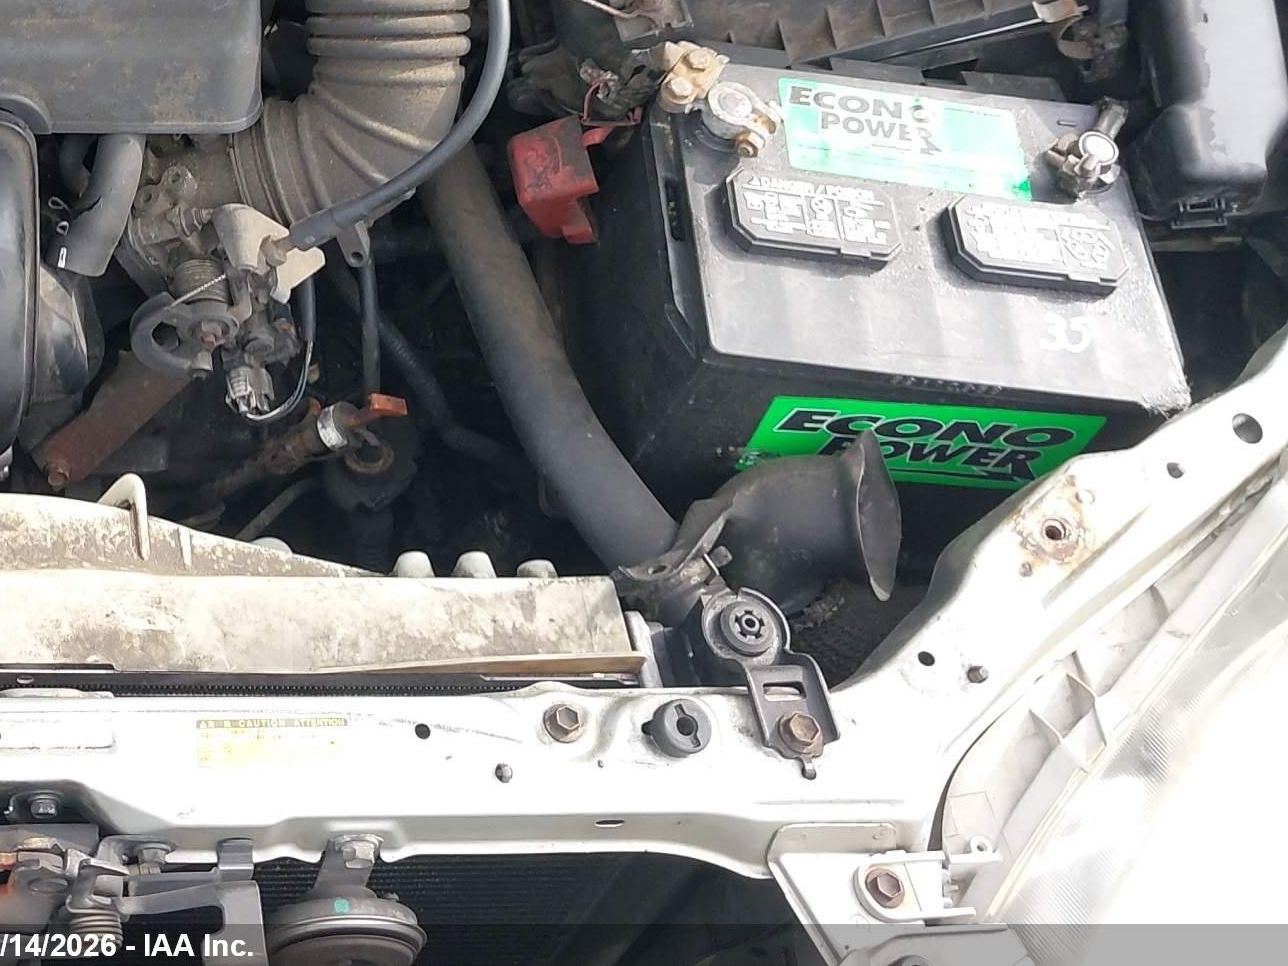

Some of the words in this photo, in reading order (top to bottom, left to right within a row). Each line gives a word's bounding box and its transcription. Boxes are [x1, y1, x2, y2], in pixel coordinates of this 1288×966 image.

[821, 111, 942, 155] POWER
[1039, 311, 1095, 353] 35
[776, 409, 1074, 447] ECONO
[817, 436, 1042, 481] POWER
[238, 719, 285, 728] CAUTION
[294, 718, 346, 727] ATTENTION
